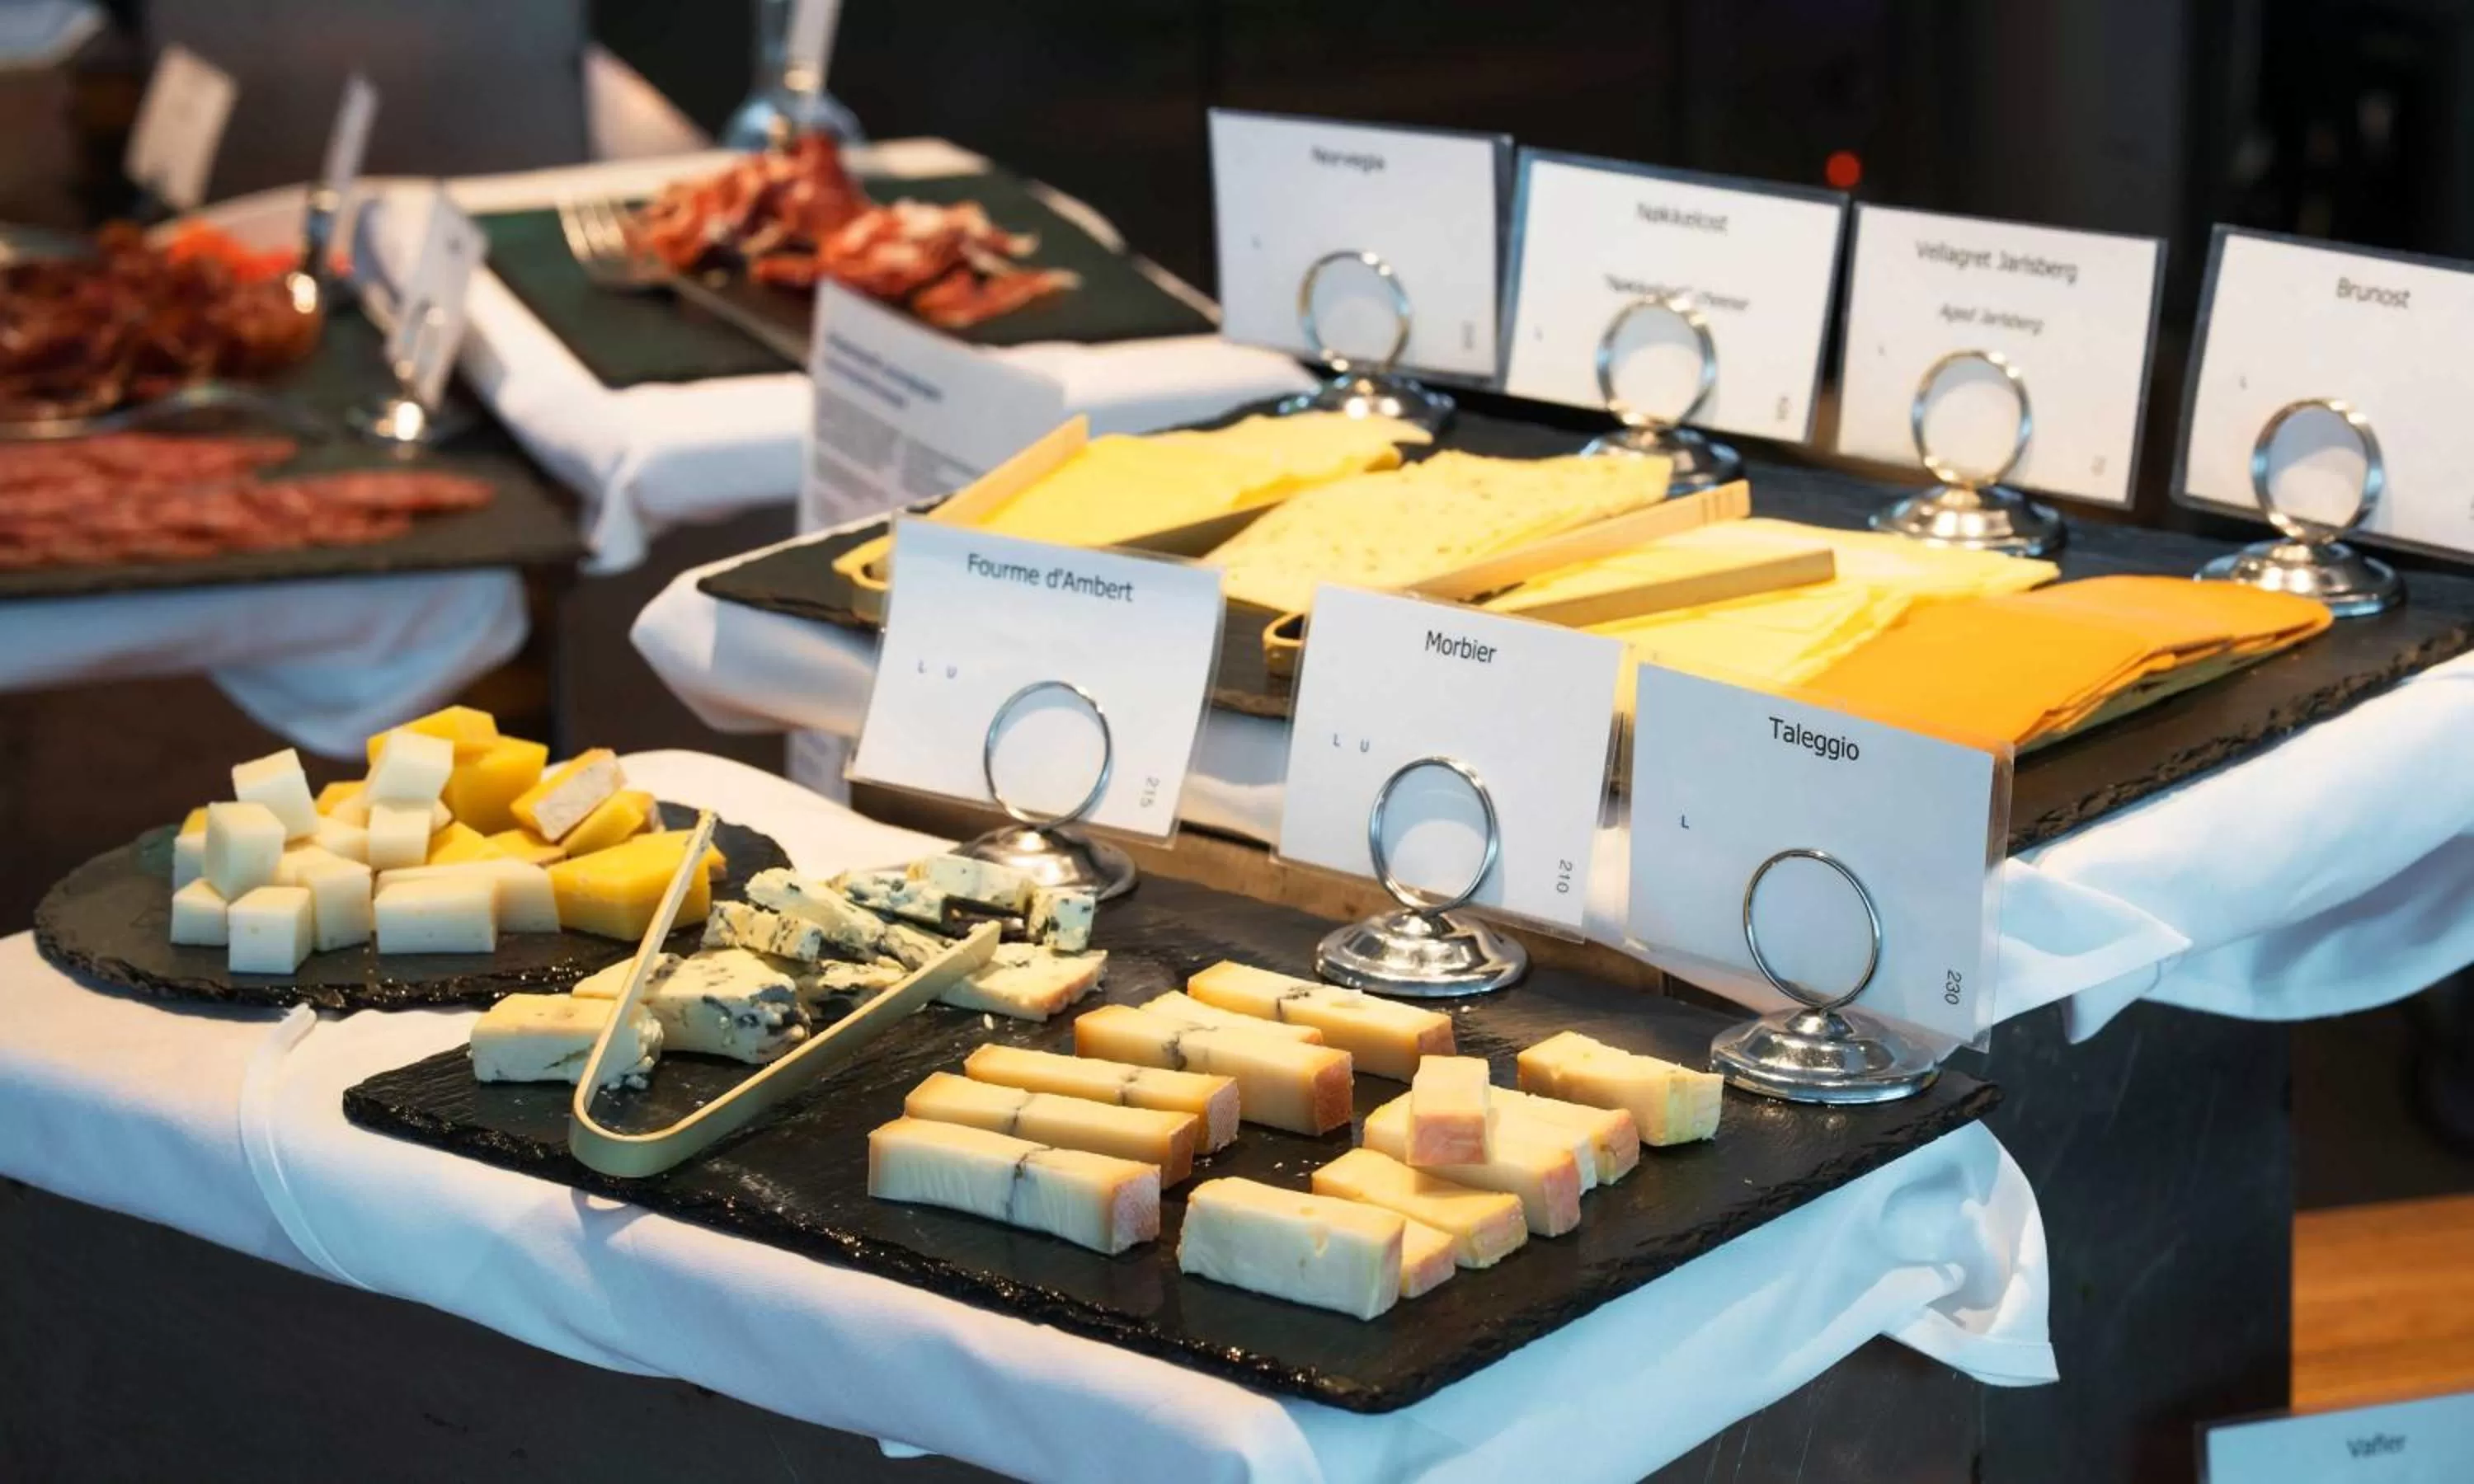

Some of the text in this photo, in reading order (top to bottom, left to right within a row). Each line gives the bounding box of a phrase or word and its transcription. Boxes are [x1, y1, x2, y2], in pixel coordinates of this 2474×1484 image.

[1916, 240, 2078, 285] Vellagret Jarlsberg
[2336, 276, 2411, 309] Brunost
[967, 552, 1133, 602] Fourme d'Ambert
[1425, 630, 1498, 663] Morbier
[1333, 733, 1370, 753] L U
[1768, 716, 1860, 760] Taleggio
[1681, 814, 1690, 829] L
[1556, 859, 1573, 893] 210
[1945, 969, 1962, 1005] 230
